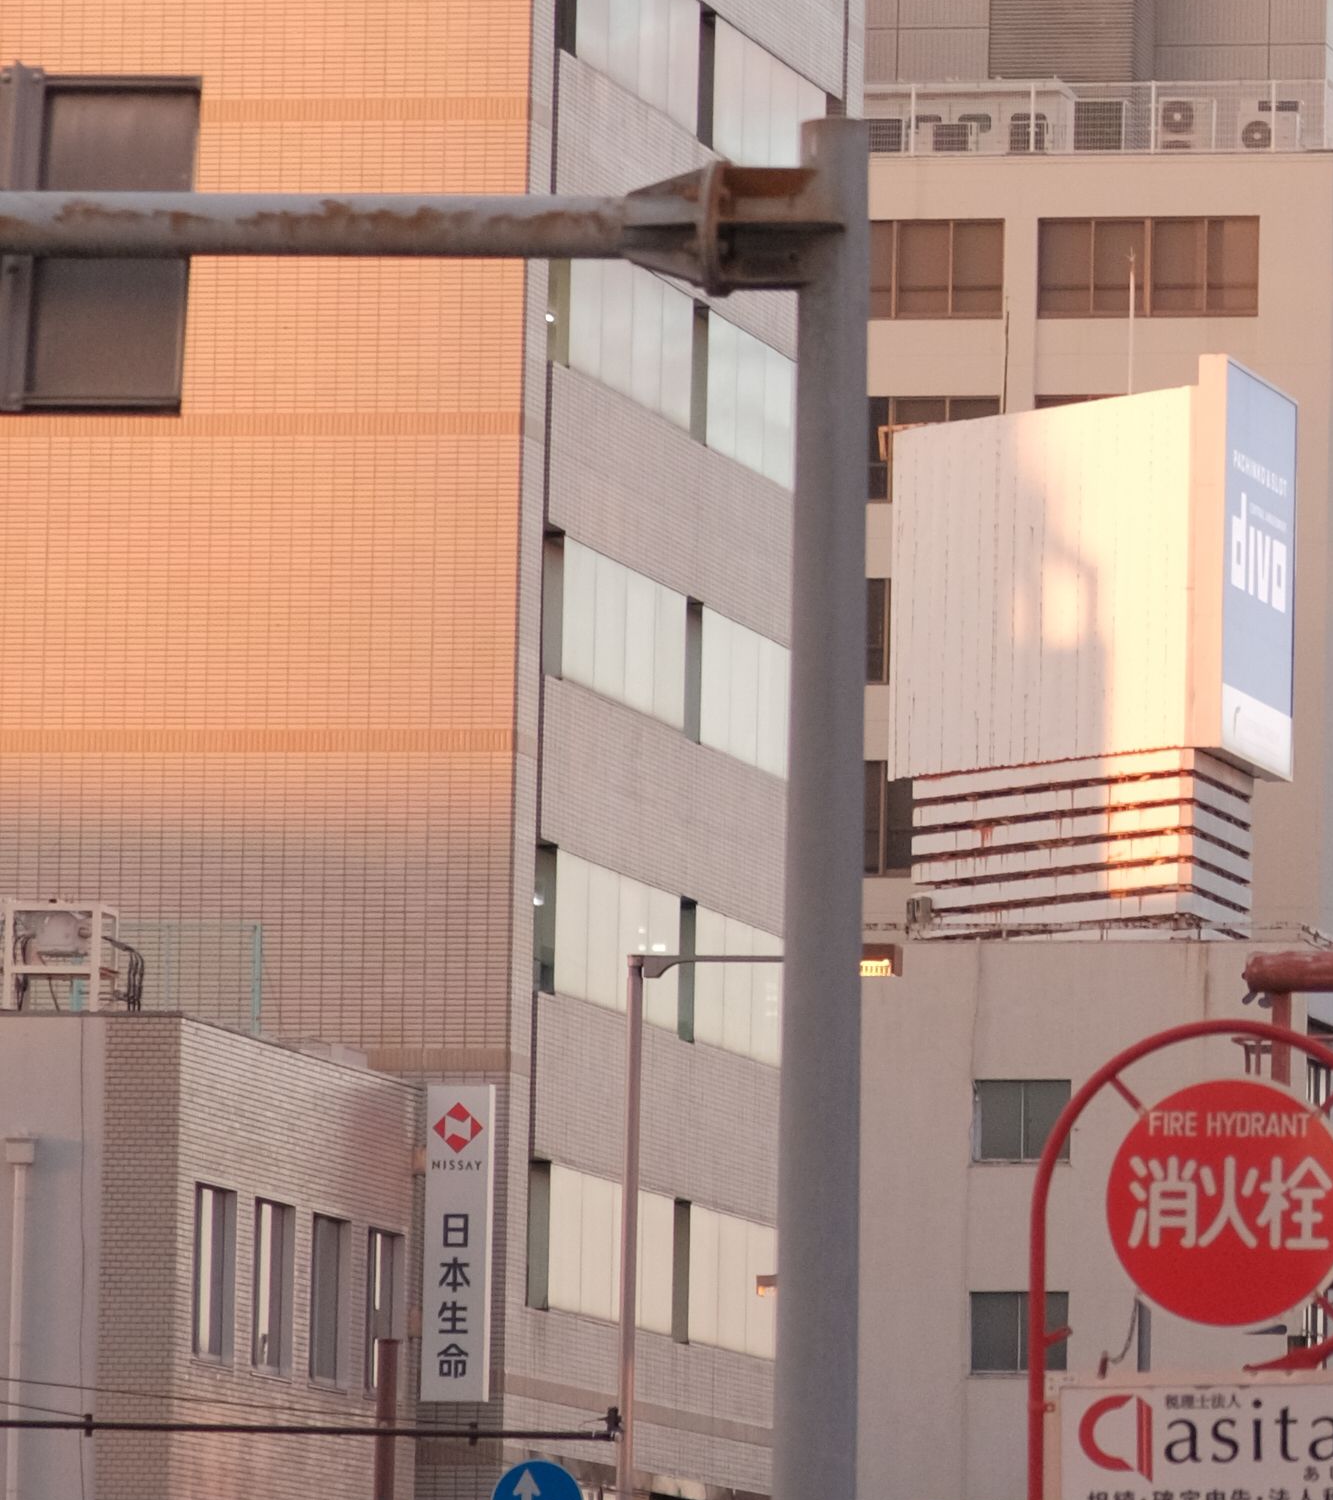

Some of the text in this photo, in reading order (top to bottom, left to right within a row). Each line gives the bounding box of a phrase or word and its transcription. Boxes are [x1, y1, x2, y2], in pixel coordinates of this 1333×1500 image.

[1149, 1111, 1312, 1138] FIRE HYDRANT
[432, 1160, 482, 1171] NISSAY
[1128, 1155, 1333, 1250] 消火栓
[437, 1213, 470, 1379] 日本生命
[1164, 1394, 1242, 1410] 税理士法人
